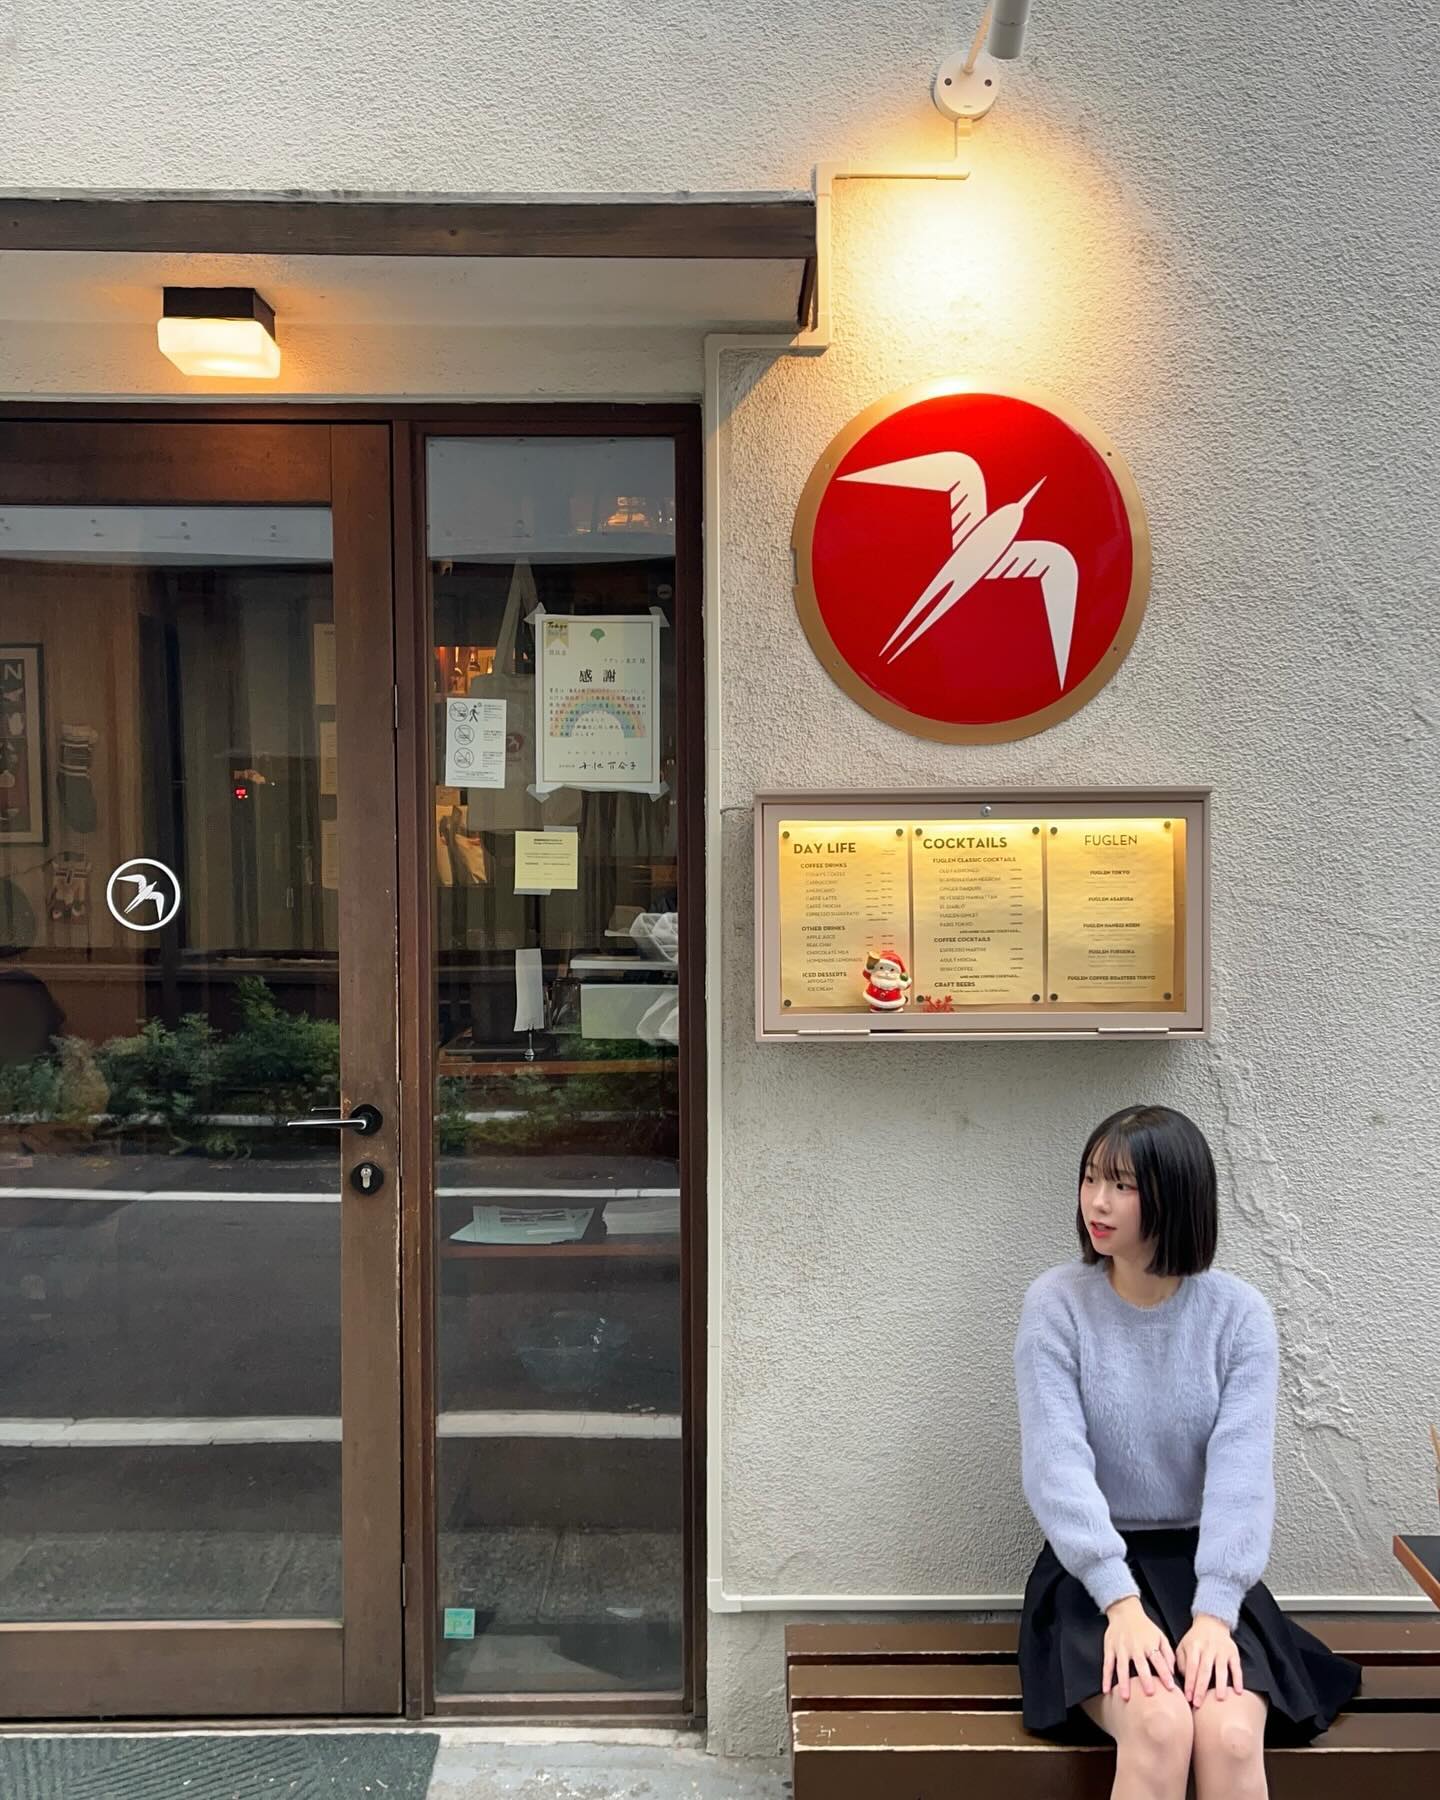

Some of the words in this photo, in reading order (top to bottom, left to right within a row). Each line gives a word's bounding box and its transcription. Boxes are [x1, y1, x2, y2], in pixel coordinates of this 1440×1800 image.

[579, 669, 616, 683] 感謝
[922, 837, 1008, 849] COCKTAILS
[1084, 834, 1138, 846] FUGLEN
[793, 843, 823, 854] DAY
[827, 843, 857, 854] LIFE
